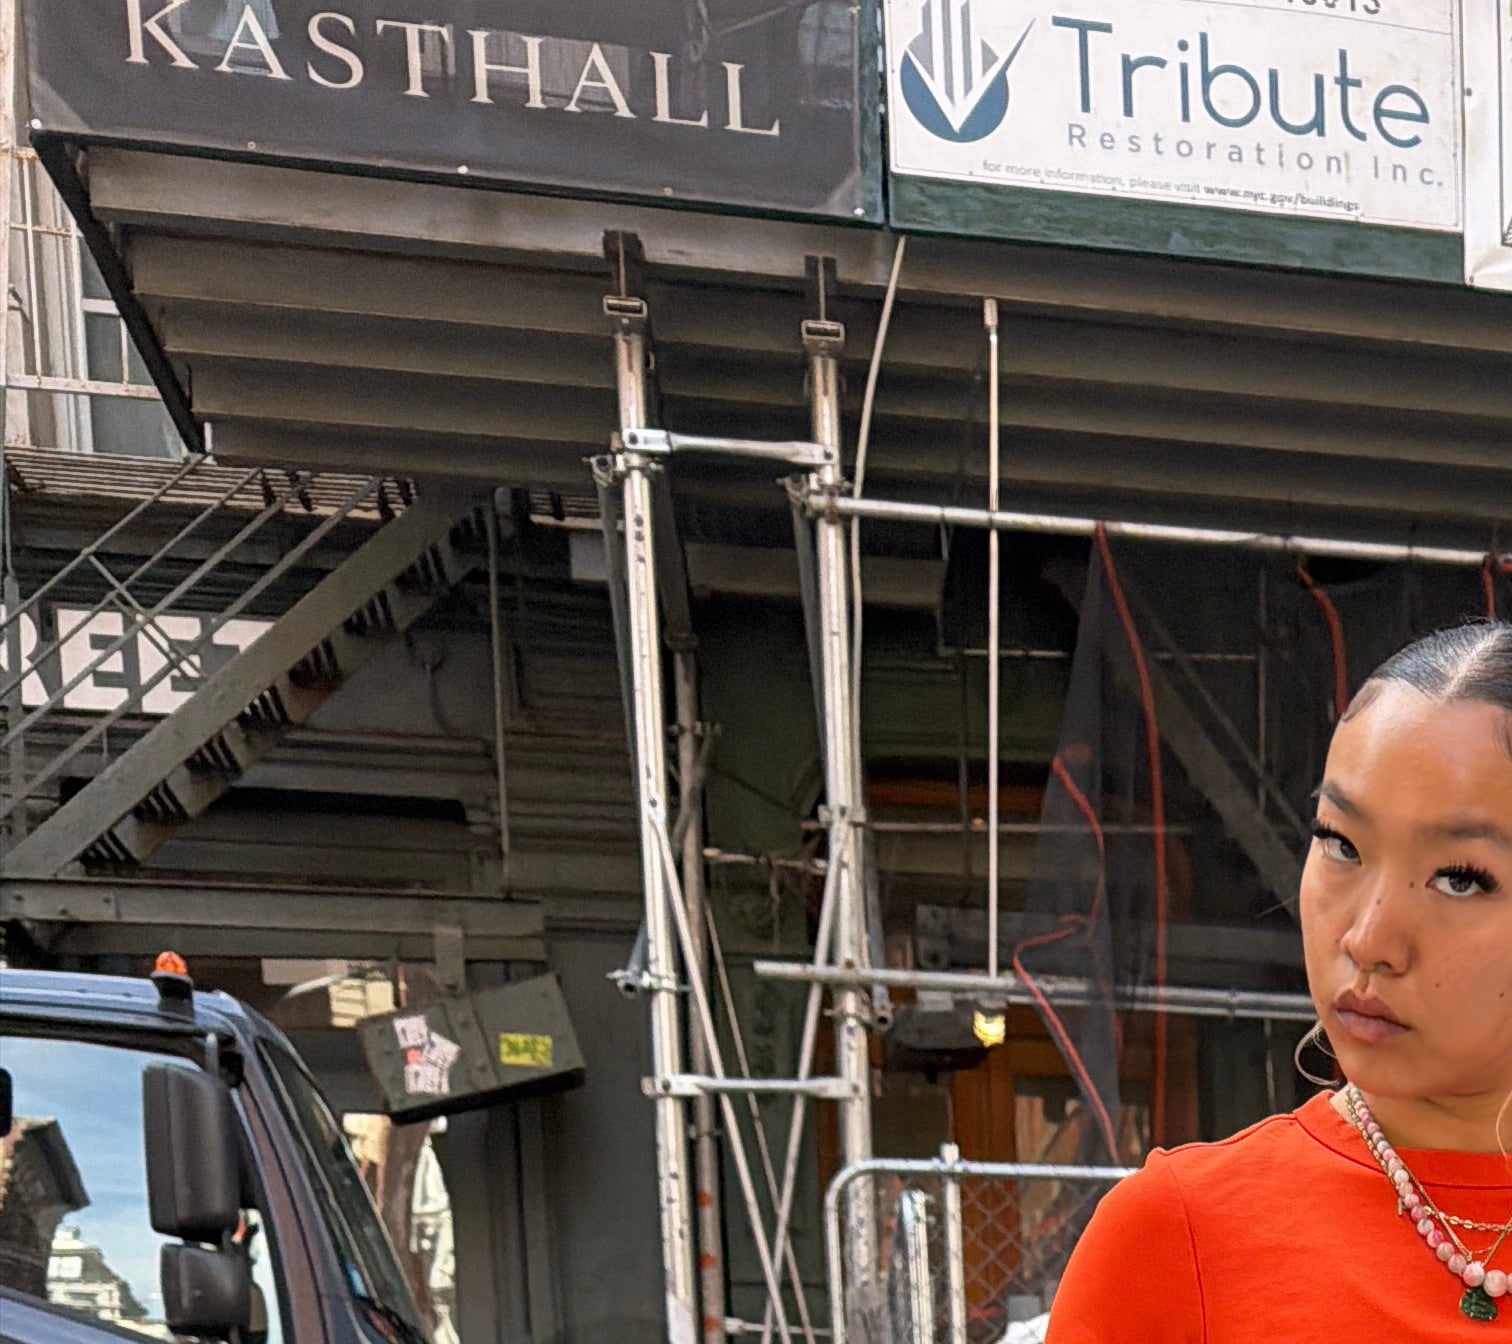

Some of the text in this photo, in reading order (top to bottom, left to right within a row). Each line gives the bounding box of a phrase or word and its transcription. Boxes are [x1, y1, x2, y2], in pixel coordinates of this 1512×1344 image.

[126, 0, 780, 137] KASTHALL
[1051, 15, 1431, 149] Tribute
[1067, 123, 1444, 187] Restoration Inc.
